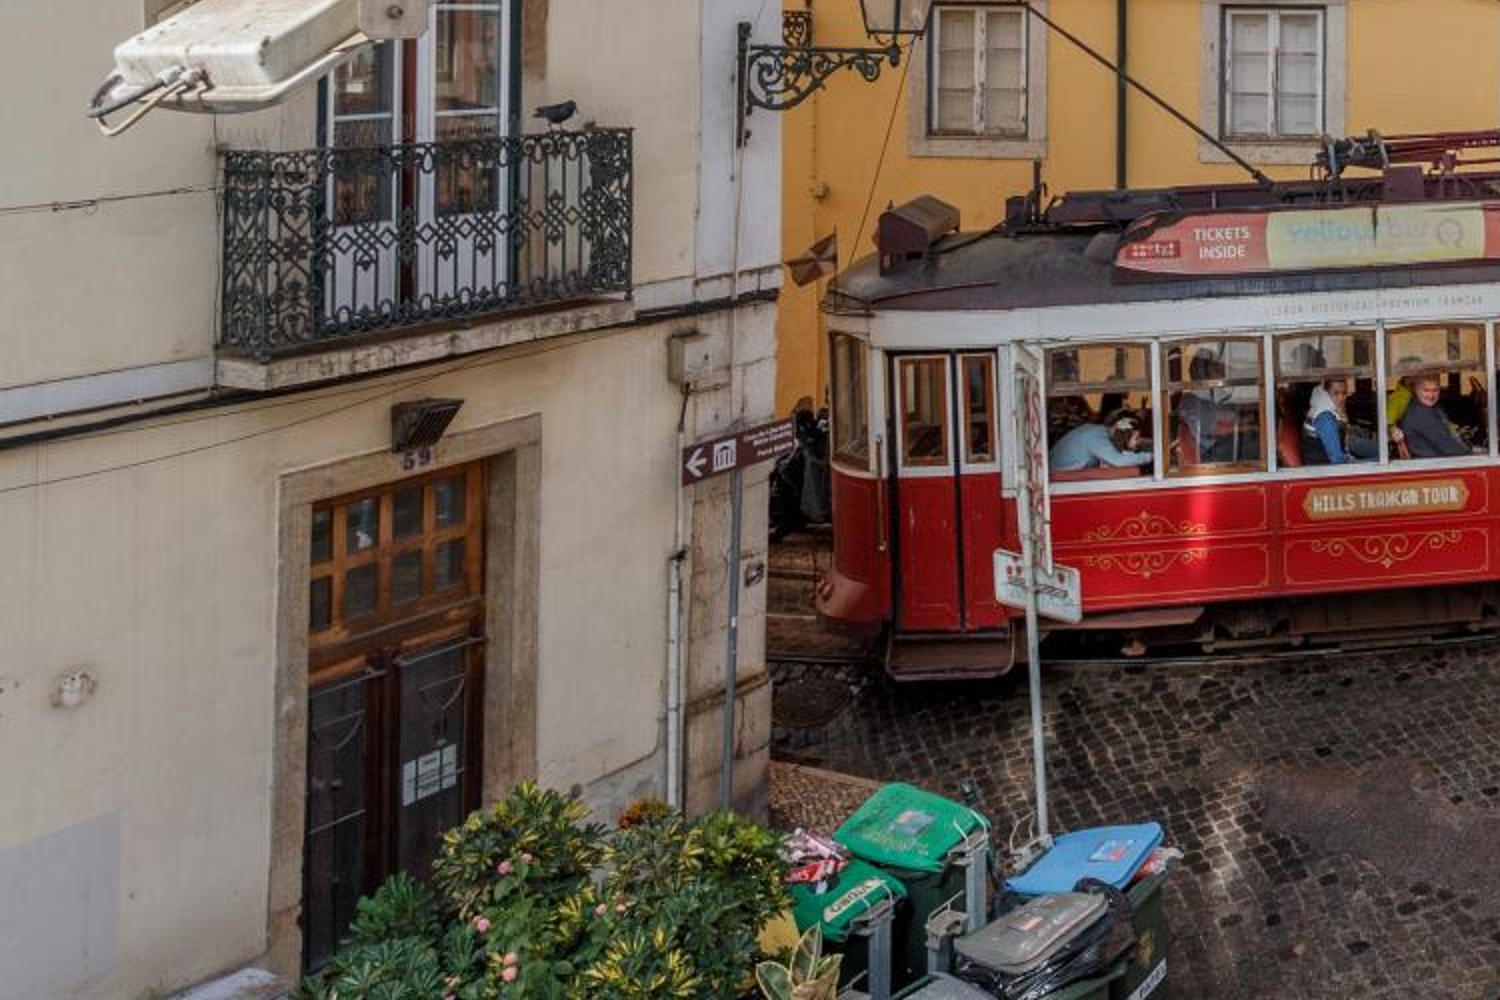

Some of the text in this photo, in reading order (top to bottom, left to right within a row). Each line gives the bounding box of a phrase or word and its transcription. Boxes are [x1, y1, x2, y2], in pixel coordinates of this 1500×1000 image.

[1193, 226, 1249, 242] TICKETS
[1199, 244, 1246, 260] INSIDE
[1313, 485, 1459, 513] HILLS TRAMCAR TOUR
